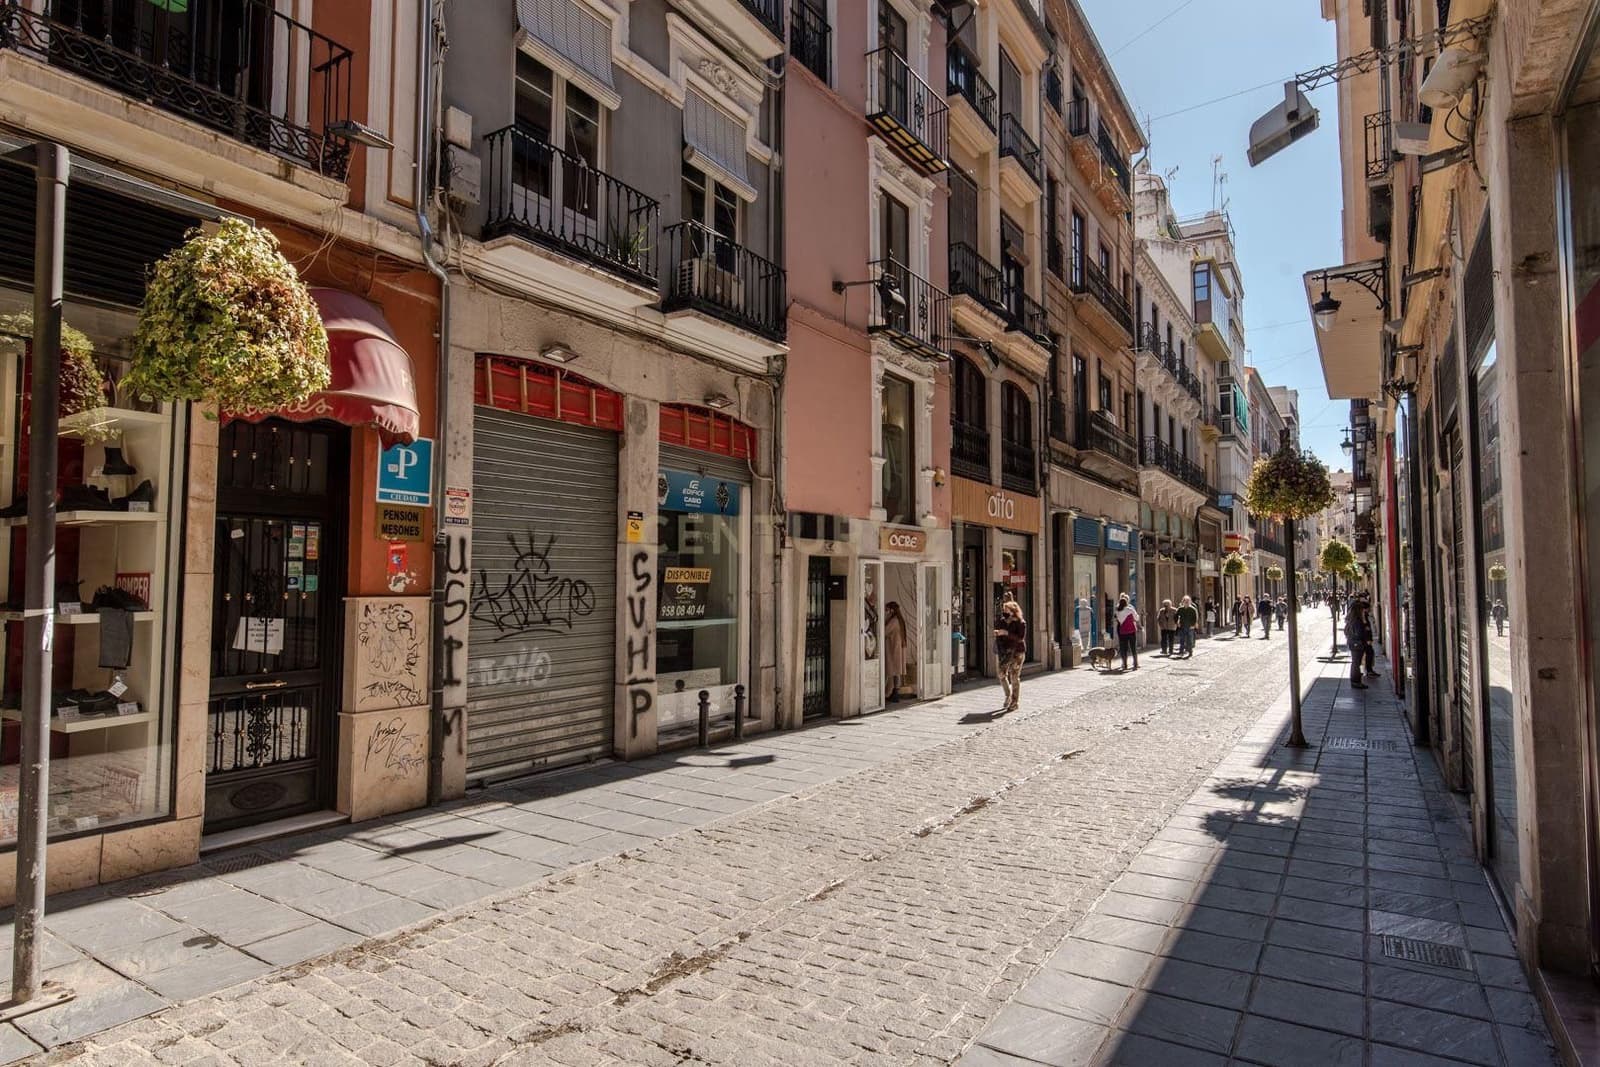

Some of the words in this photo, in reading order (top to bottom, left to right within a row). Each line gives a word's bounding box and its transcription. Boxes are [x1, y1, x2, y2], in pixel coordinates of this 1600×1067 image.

[395, 447, 419, 480] P
[390, 493, 419, 503] CIUDAD
[682, 487, 705, 498] EDIFICE
[683, 496, 702, 504] CASIO
[383, 509, 419, 522] PENSION
[381, 523, 420, 537] MESONES
[889, 534, 918, 548] OCRE
[666, 569, 710, 581] DISPONIBLE
[661, 605, 675, 616] 958
[676, 605, 686, 616] 08
[686, 604, 696, 616] 40
[696, 603, 705, 616] 44
